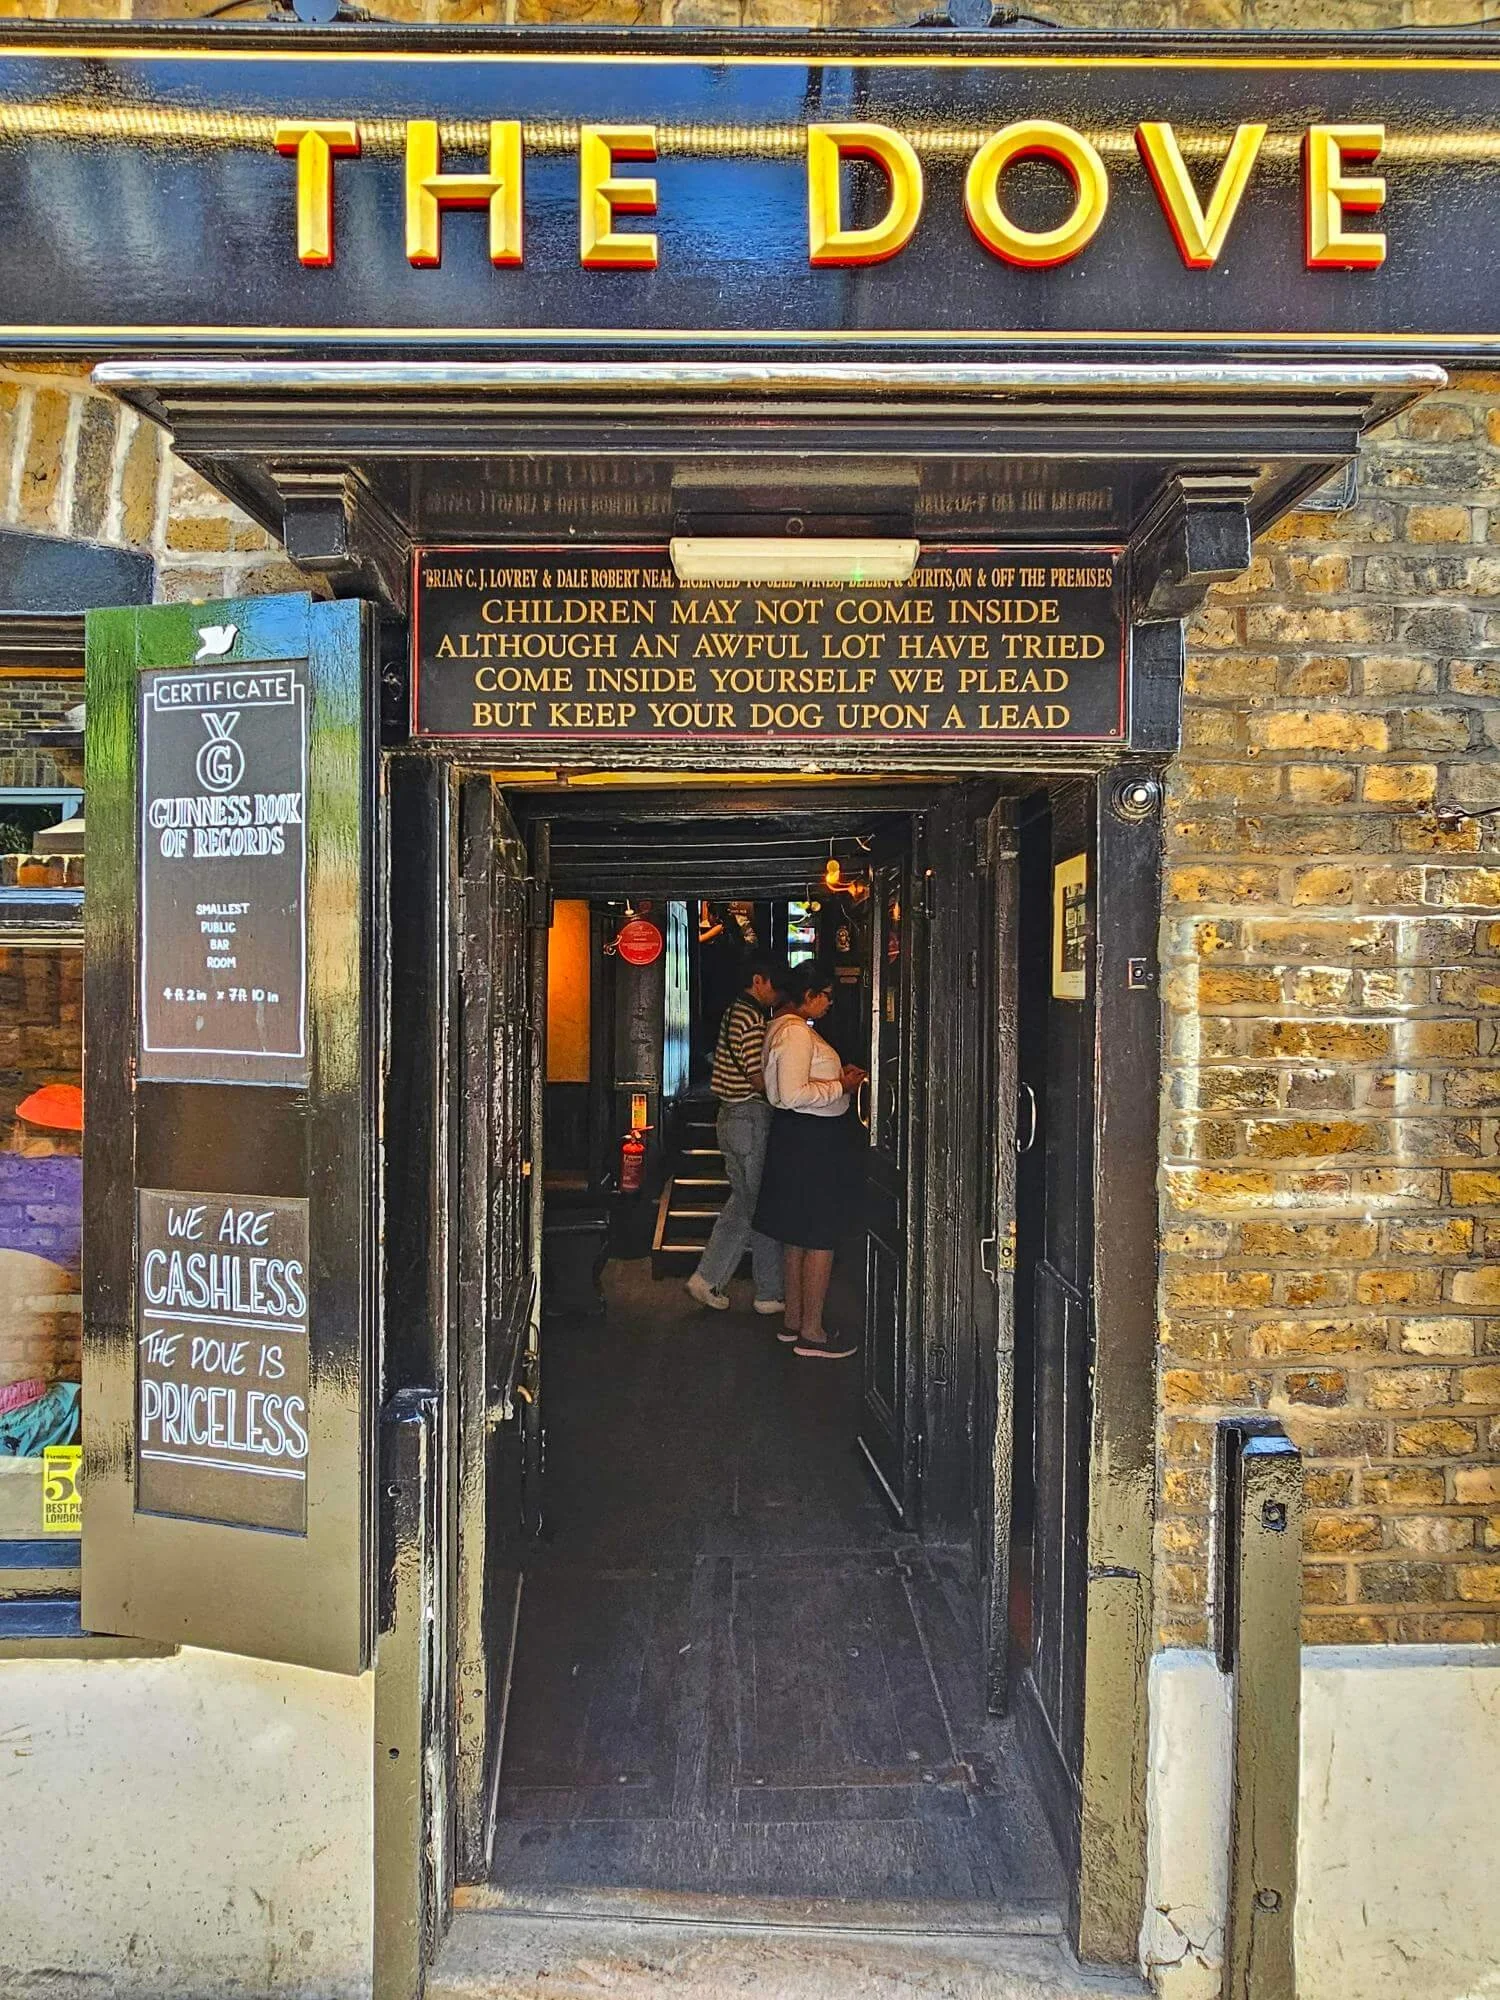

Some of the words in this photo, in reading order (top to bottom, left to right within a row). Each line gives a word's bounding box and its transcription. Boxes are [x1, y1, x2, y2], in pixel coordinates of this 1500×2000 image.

[275, 119, 660, 270] THE
[806, 119, 1388, 271] DOVE
[425, 569, 463, 588] BRIAN
[490, 569, 538, 589] LOVREY
[543, 570, 552, 588] &
[557, 569, 589, 589] DALE
[591, 569, 640, 589] ROBERT
[642, 568, 674, 589] NEAL
[978, 568, 987, 588] &
[992, 568, 1016, 588] OFF
[1019, 568, 1046, 588] THE
[1051, 567, 1113, 588] PREMISES
[481, 599, 656, 625] CHILDREN
[671, 599, 743, 625] MAY
[755, 598, 824, 625] NOT
[835, 599, 934, 625] COME
[948, 599, 1060, 625] INSIDE
[436, 633, 618, 659] ALTHOUGH
[631, 633, 679, 659] AN
[693, 633, 809, 659] AWFUL
[822, 633, 886, 660] LOT
[899, 634, 990, 660] HAVE
[1002, 634, 1106, 660] TRIED
[158, 677, 288, 704] CERTIFICATE
[474, 667, 573, 693] COME
[586, 667, 697, 693] INSIDE
[709, 667, 877, 694] YOURSELF
[888, 668, 944, 694] WE
[957, 668, 1070, 694] PLEAD
[472, 701, 537, 728] BUT
[549, 702, 637, 728] KEEP
[649, 703, 737, 728] YOUR
[750, 703, 825, 729] DOG
[838, 703, 930, 729] UPON
[942, 703, 968, 729] A
[980, 704, 1071, 730] LEAD
[206, 744, 233, 784] G
[149, 794, 252, 829] GUINNESS
[253, 792, 303, 825] BOOK
[160, 828, 188, 858] OF
[192, 825, 286, 858] RECORDS
[195, 902, 251, 916] SMALLEST
[200, 920, 236, 934] PUBLIC
[209, 938, 230, 951] BAR
[206, 956, 237, 969] ROOM
[167, 1205, 207, 1241] WE
[218, 1207, 274, 1246] ARE
[144, 1249, 307, 1318] CASHLESS
[139, 1328, 184, 1367] THE
[191, 1336, 250, 1375] DOVE
[258, 1344, 286, 1379] IS
[141, 1379, 309, 1459] PRICELESS
[46, 1503, 68, 1513] BEST
